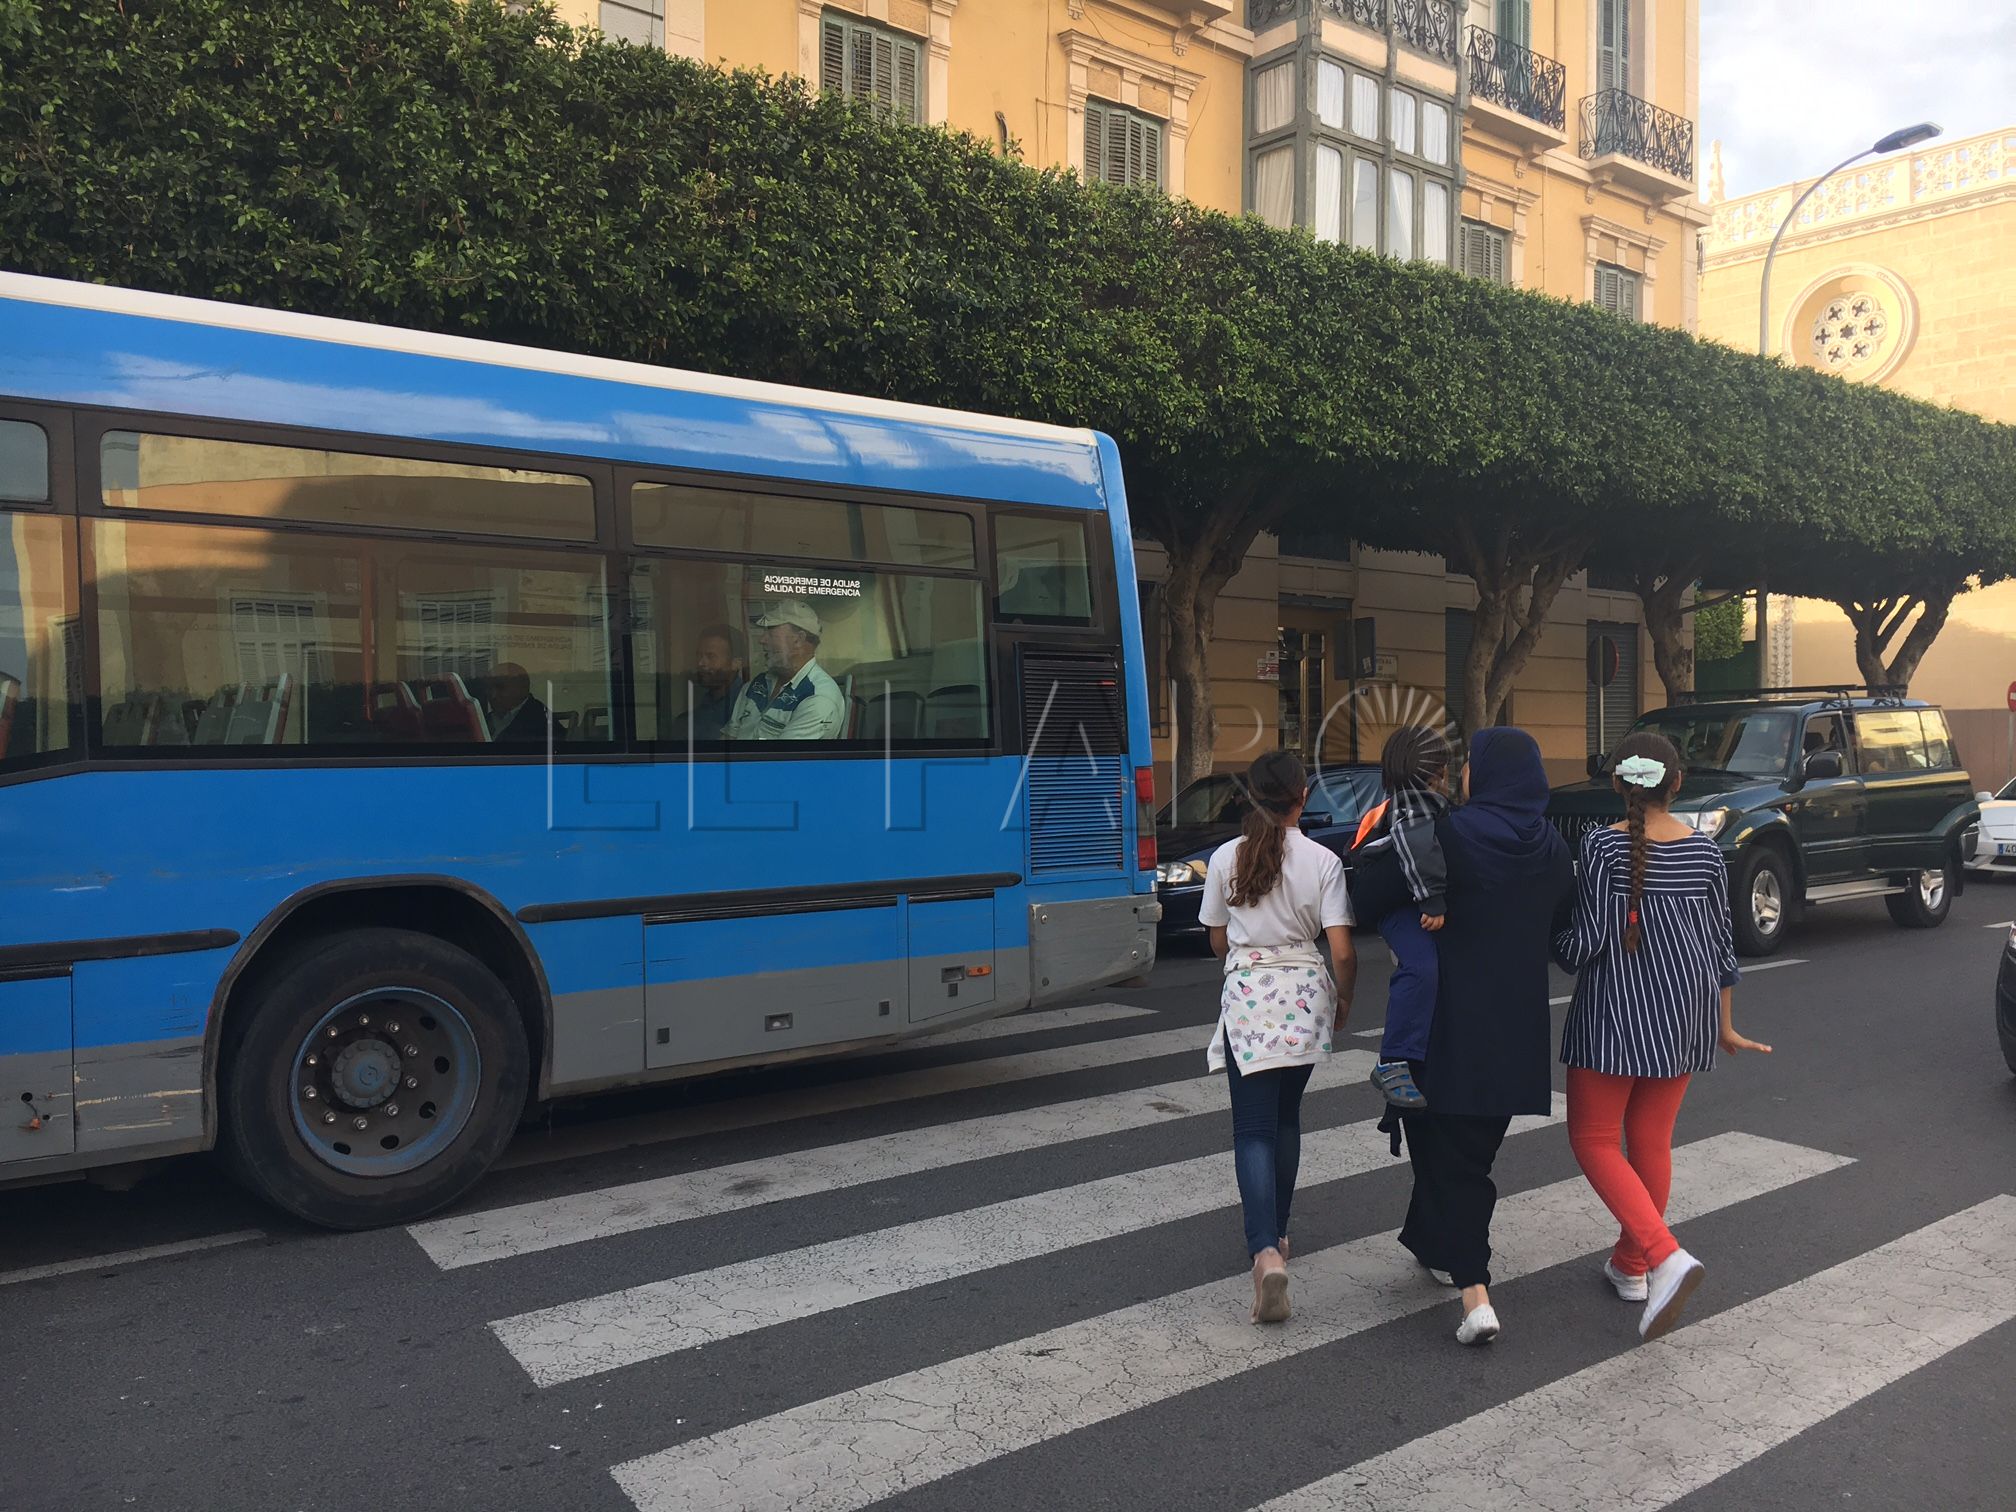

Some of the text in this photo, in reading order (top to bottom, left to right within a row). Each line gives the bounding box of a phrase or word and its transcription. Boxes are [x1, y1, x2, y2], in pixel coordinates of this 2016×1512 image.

[764, 584, 861, 597] SALIDA DE EMERGENCIA
